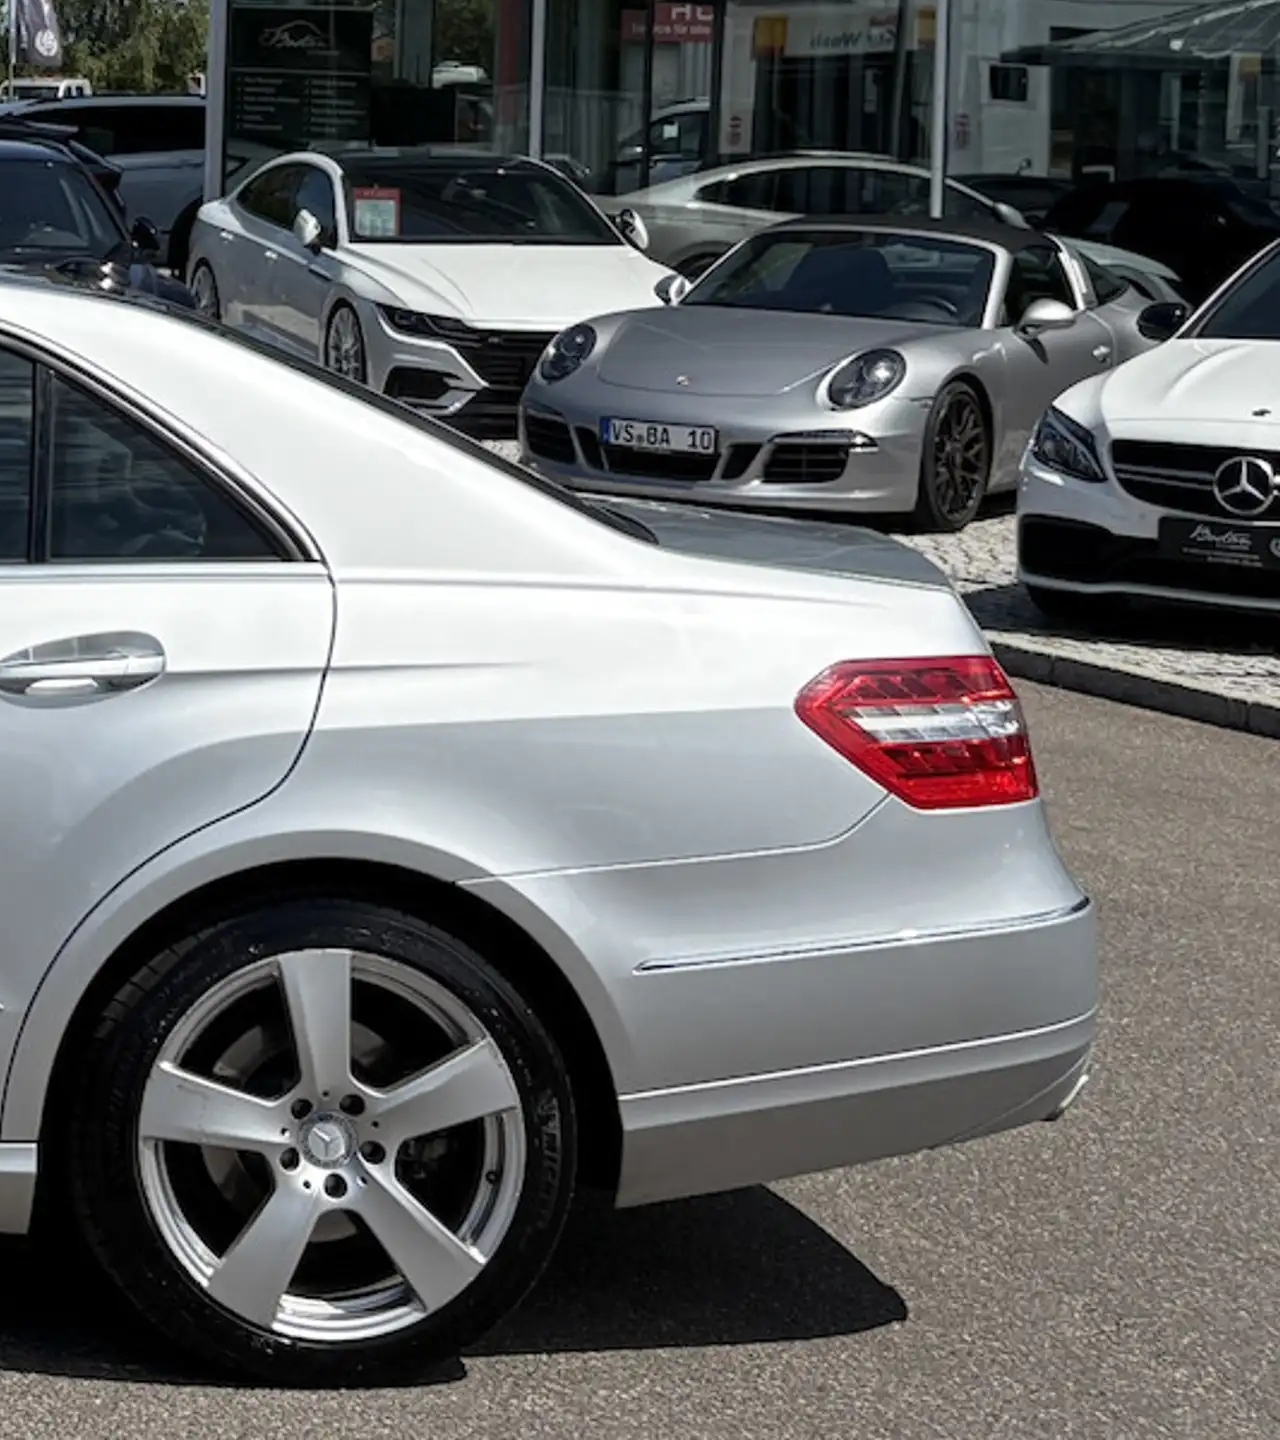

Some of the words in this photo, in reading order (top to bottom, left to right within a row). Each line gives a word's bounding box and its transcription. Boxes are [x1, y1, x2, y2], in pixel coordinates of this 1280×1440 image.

[612, 422, 635, 443] VS
[646, 425, 671, 446] BA
[687, 429, 712, 450] 10
